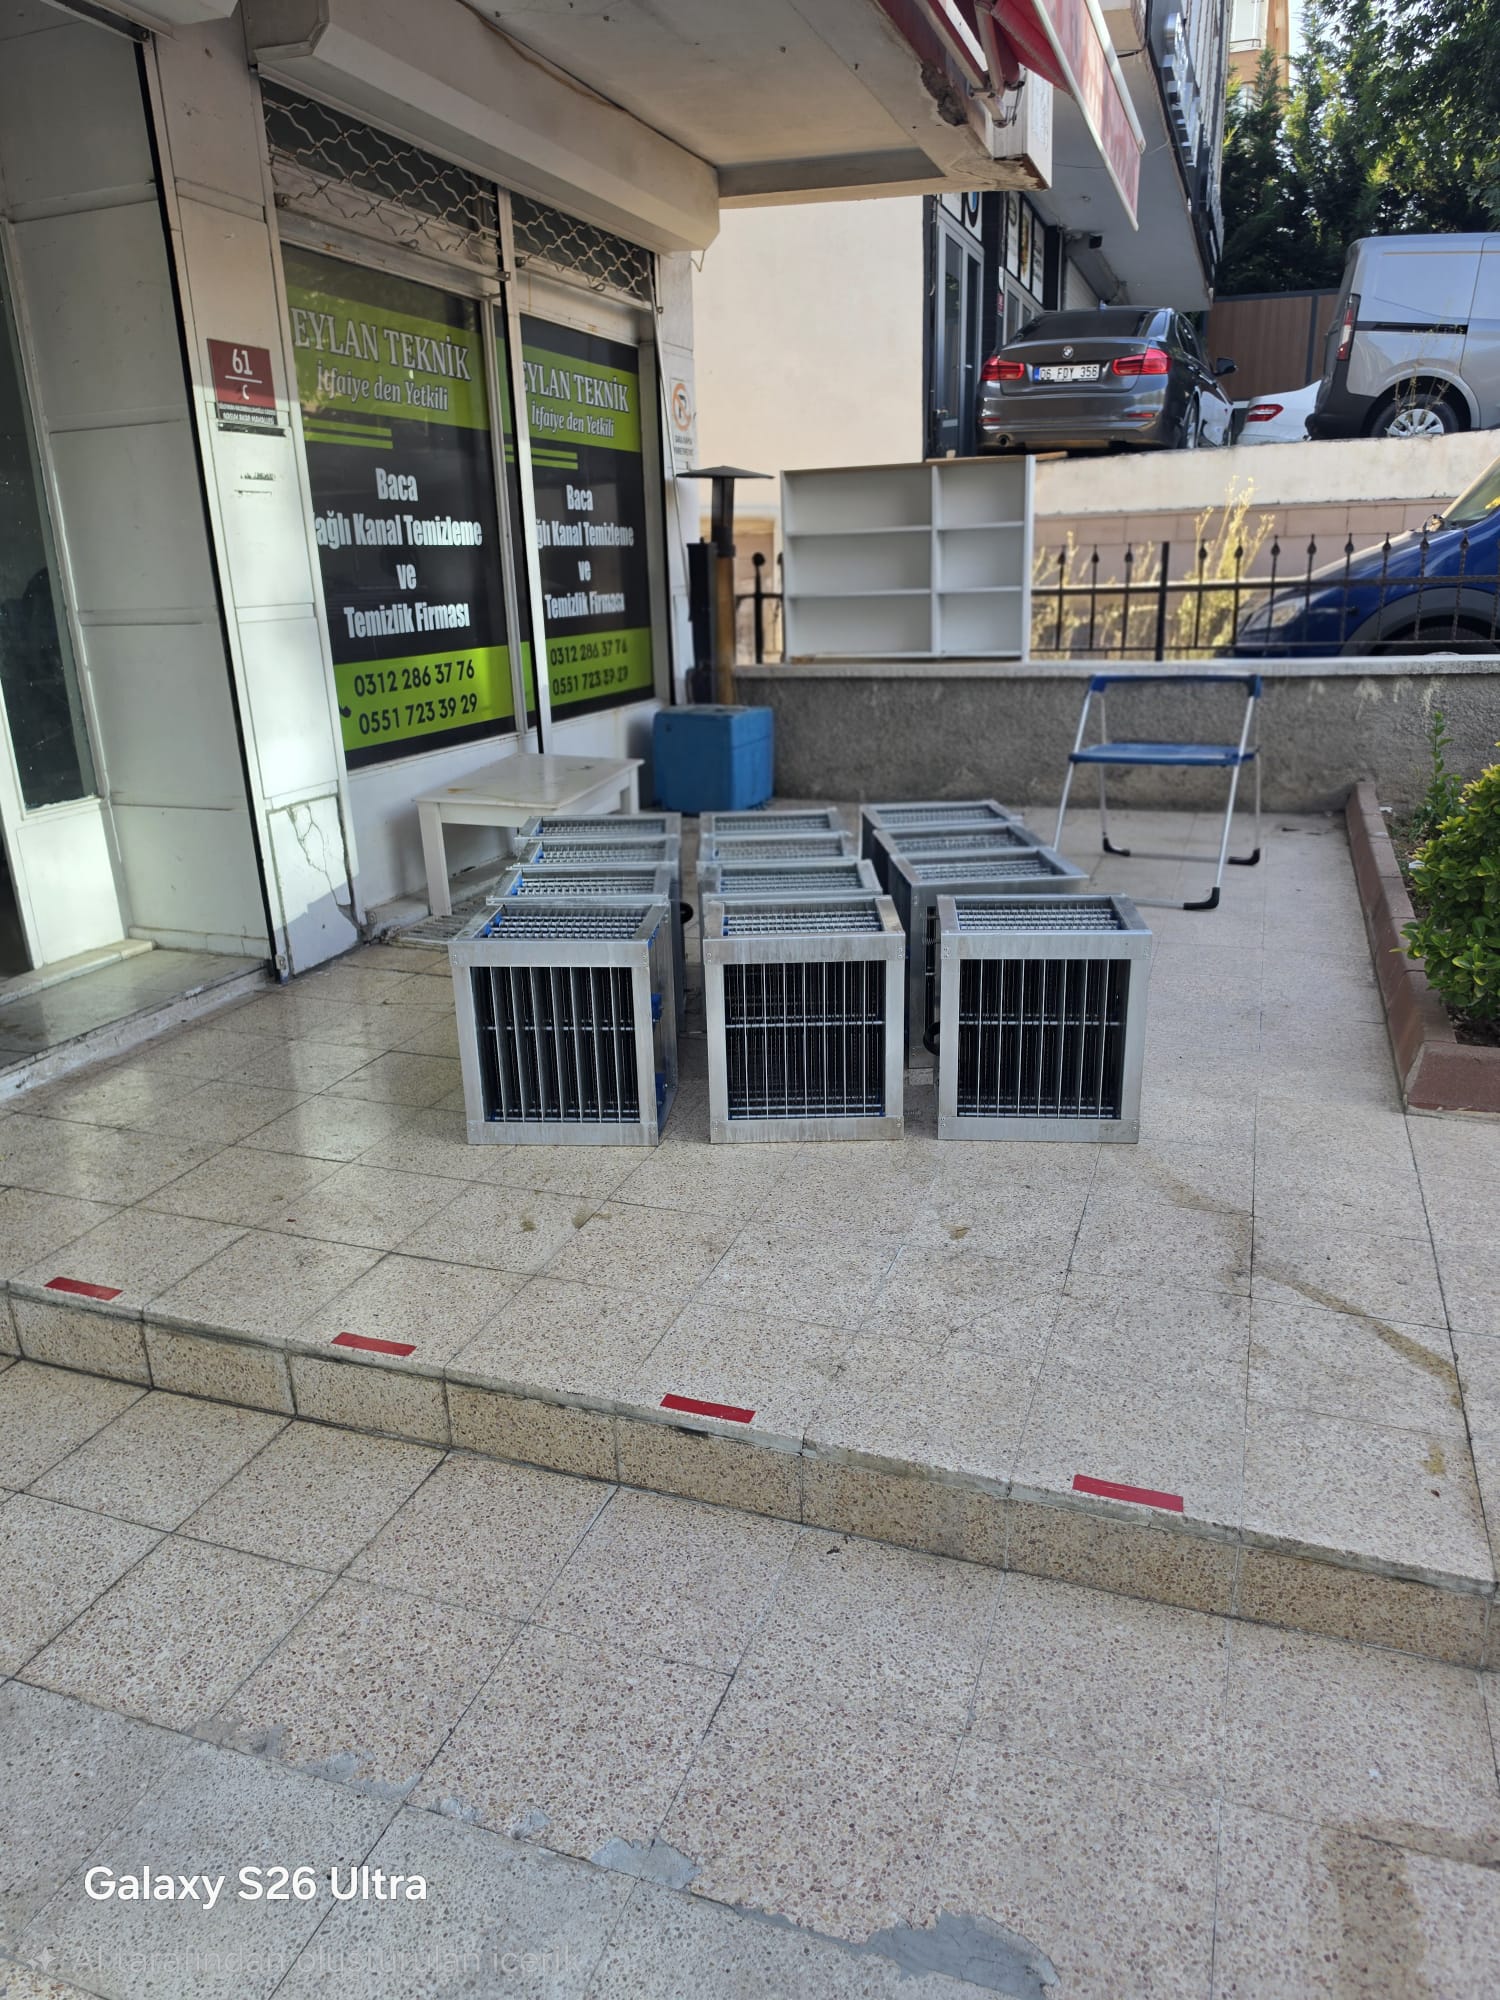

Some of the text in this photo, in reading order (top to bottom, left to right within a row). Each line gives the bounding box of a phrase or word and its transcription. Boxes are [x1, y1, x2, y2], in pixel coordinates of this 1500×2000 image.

[232, 348, 253, 376] 61
[382, 328, 472, 381] TEKNİK
[1080, 365, 1097, 378] 356
[242, 384, 250, 400] C
[373, 375, 401, 403] den
[404, 380, 449, 412] Yetkili
[573, 373, 630, 413] TEKNİK
[566, 410, 585, 433] den
[586, 415, 616, 438] Yetkili
[375, 467, 419, 502] Baca
[566, 484, 594, 511] Baca
[314, 510, 484, 550] ağlı Kanal Temizleme
[551, 520, 584, 546] Kanal
[582, 521, 635, 547] Temizleme
[396, 563, 417, 590] ve
[578, 560, 592, 582] ve
[543, 591, 590, 620] Temizlik
[343, 601, 471, 639] Temizlik Firması
[550, 645, 578, 666] 0312
[580, 643, 599, 661] 286
[602, 640, 613, 657] 37
[354, 659, 475, 697] 0312 286 37 76
[552, 675, 579, 696] 0551
[581, 670, 601, 690] 723
[358, 693, 478, 735] 0551 723 39 29
